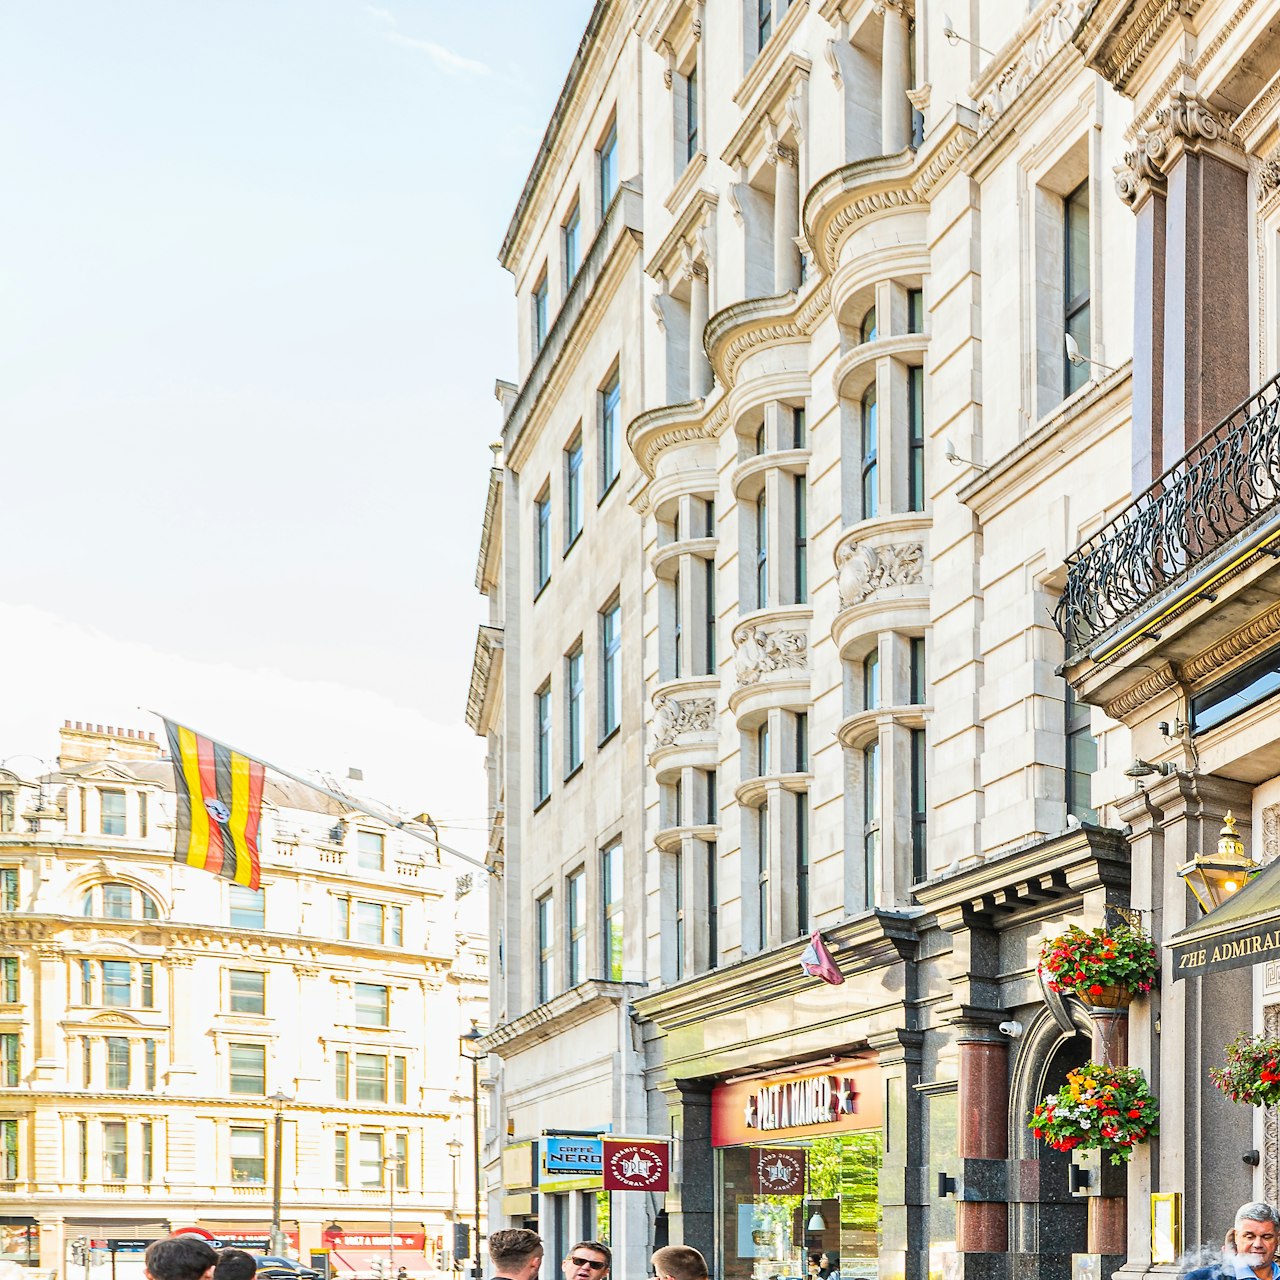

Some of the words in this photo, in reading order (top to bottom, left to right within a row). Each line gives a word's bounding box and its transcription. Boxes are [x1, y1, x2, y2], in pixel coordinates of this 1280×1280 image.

[1179, 944, 1207, 970] THE
[550, 1153, 602, 1164] NERO
[611, 1146, 638, 1166] ORGANIC
[640, 1147, 663, 1167] COFFEE
[612, 1170, 644, 1187] NATURAL
[645, 1171, 662, 1186] FOOD
